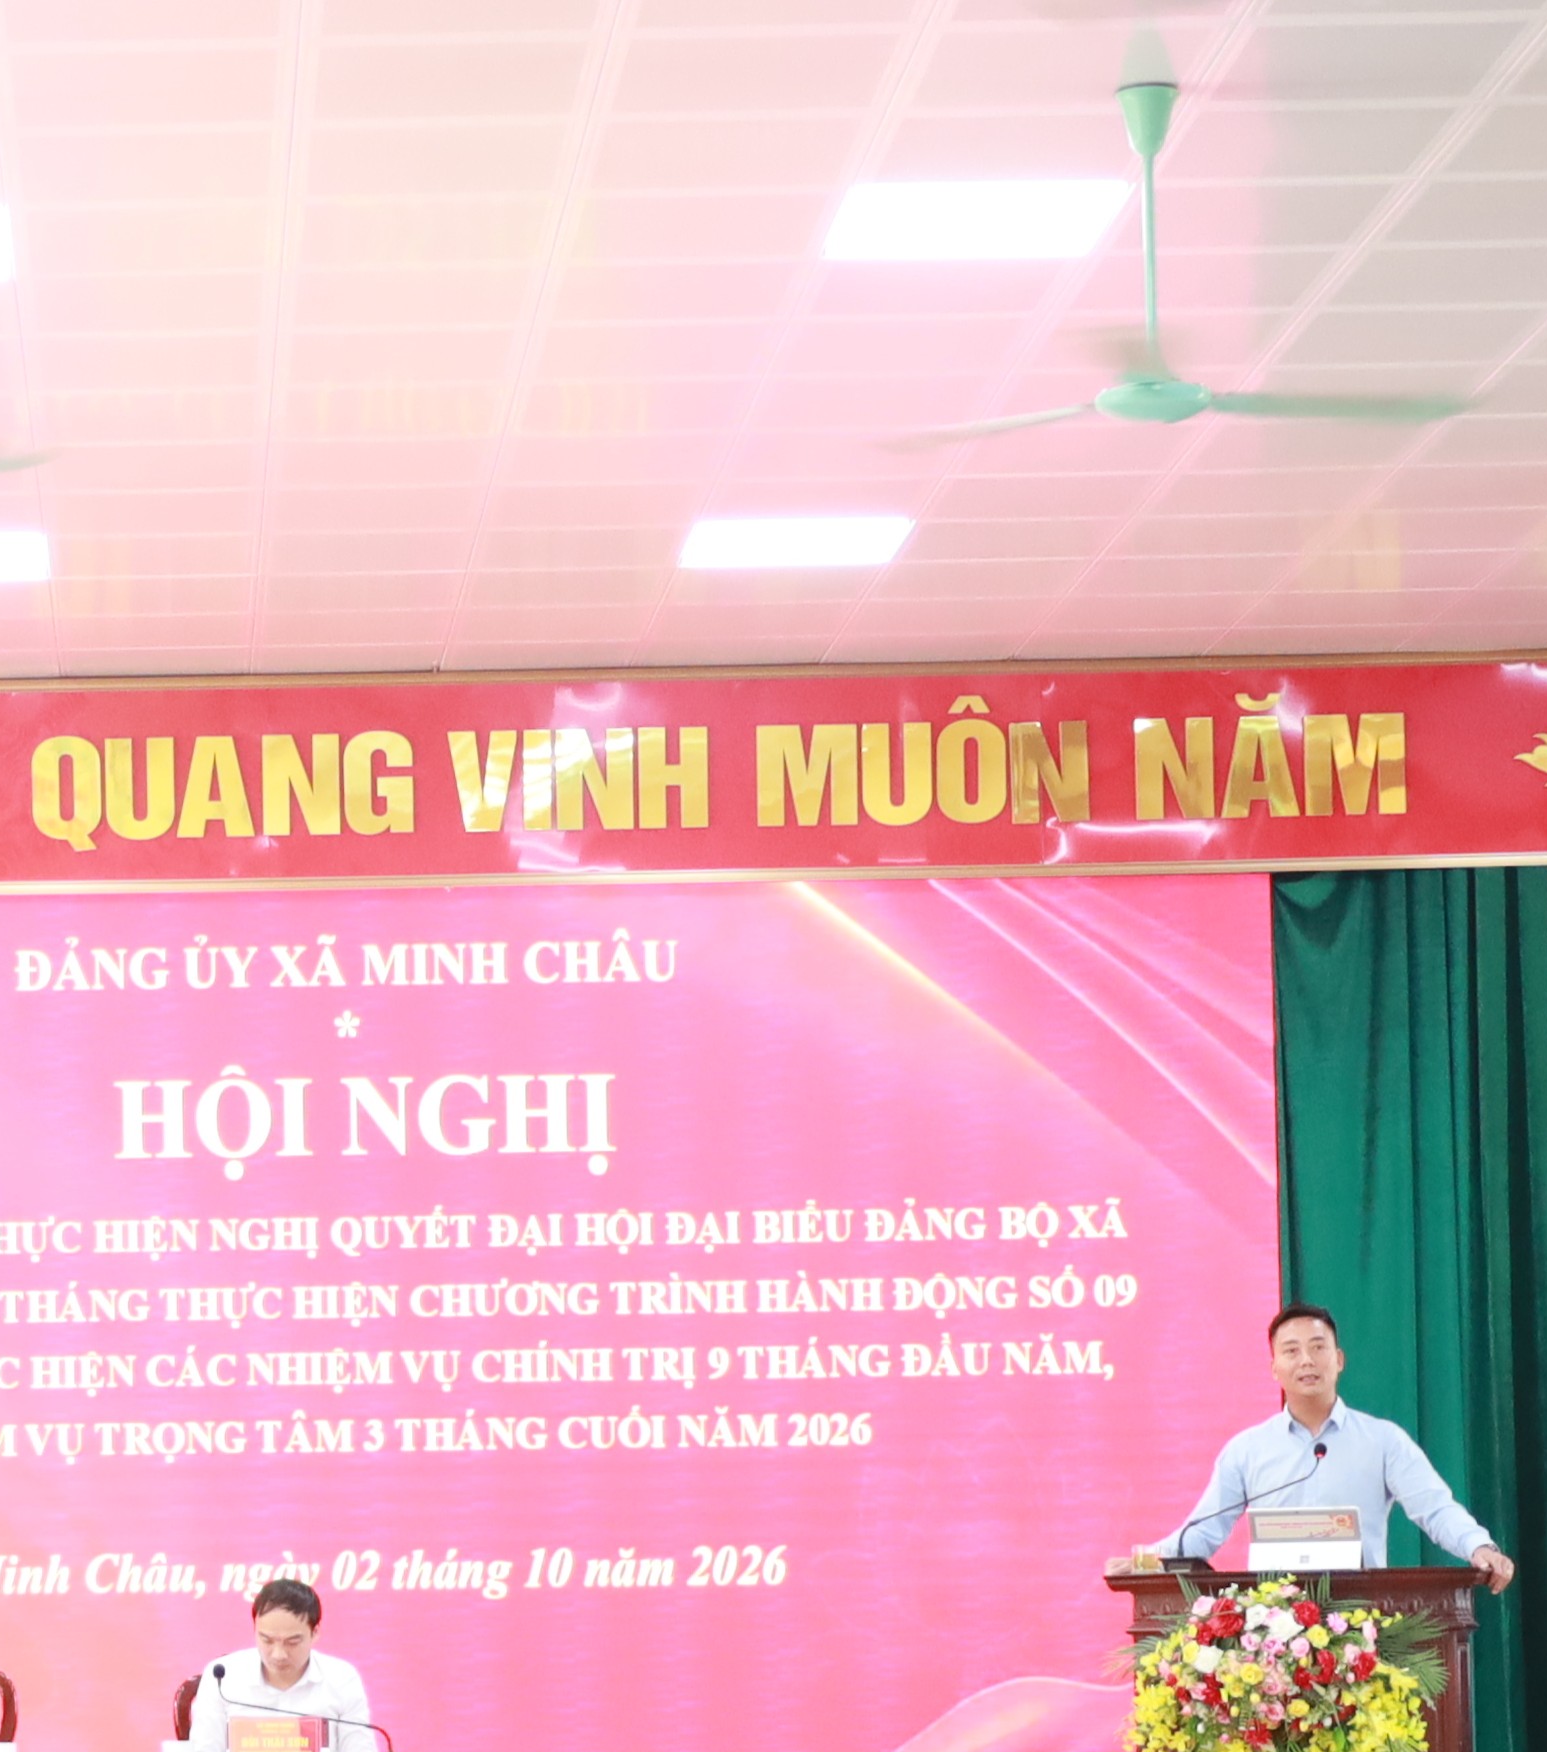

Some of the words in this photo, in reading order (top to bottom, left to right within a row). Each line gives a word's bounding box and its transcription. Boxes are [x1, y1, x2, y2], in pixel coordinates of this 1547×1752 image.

[32, 732, 414, 850] QUANG
[449, 727, 709, 831] VINH
[757, 696, 1089, 826] MUÔN
[1137, 695, 1407, 819] NĂM
[14, 936, 169, 992] ĐẢNG
[184, 935, 258, 989] ỦY
[270, 934, 346, 987] XÃ
[362, 942, 508, 986] MINH
[523, 927, 678, 984] CHÂU
[114, 1065, 313, 1181] HỘI
[340, 1073, 617, 1175] NGHỊ
[93, 1209, 199, 1262] HIỆN
[209, 1217, 319, 1259] NGHỊ
[330, 1205, 476, 1257] QUYẾT
[488, 1213, 563, 1256] ĐẠI
[575, 1208, 654, 1254] HỘI
[665, 1211, 740, 1253] ĐẠI
[864, 1198, 986, 1242] ĐẢNG
[999, 1202, 1059, 1248] BỘ
[1068, 1197, 1128, 1238] XÃ
[158, 1281, 282, 1329] THỰC
[292, 1281, 399, 1327] HIỆN
[609, 1272, 747, 1315] TRÌNH
[757, 1270, 884, 1313] HÀNH
[893, 1273, 1018, 1319] ĐỘNG
[1029, 1264, 1085, 1308] SỐ
[1094, 1274, 1138, 1307] 09
[30, 1344, 137, 1397] HIỆN
[145, 1345, 237, 1387] CÁC
[246, 1347, 393, 1394] NHIỆM
[400, 1350, 461, 1392] VỤ
[472, 1340, 613, 1383] CHÍNH
[622, 1347, 696, 1389] TRỊ
[708, 1347, 730, 1379] 9
[737, 1336, 891, 1379] THÁNG
[1002, 1333, 1114, 1380] NĂM,
[24, 1423, 85, 1465] VỤ
[93, 1421, 247, 1464] TRỌNG
[255, 1409, 354, 1454] TÂM
[363, 1419, 385, 1452] 3
[394, 1409, 548, 1452] THÁNG
[558, 1405, 666, 1449] CUỐI
[678, 1406, 778, 1448] NĂM
[788, 1413, 872, 1447] 2026
[84, 1552, 206, 1599] Châu,
[332, 1550, 381, 1591] 02
[392, 1548, 508, 1600] tháng
[525, 1547, 573, 1588] 10
[584, 1548, 674, 1587] năm
[687, 1545, 786, 1586] 2026
